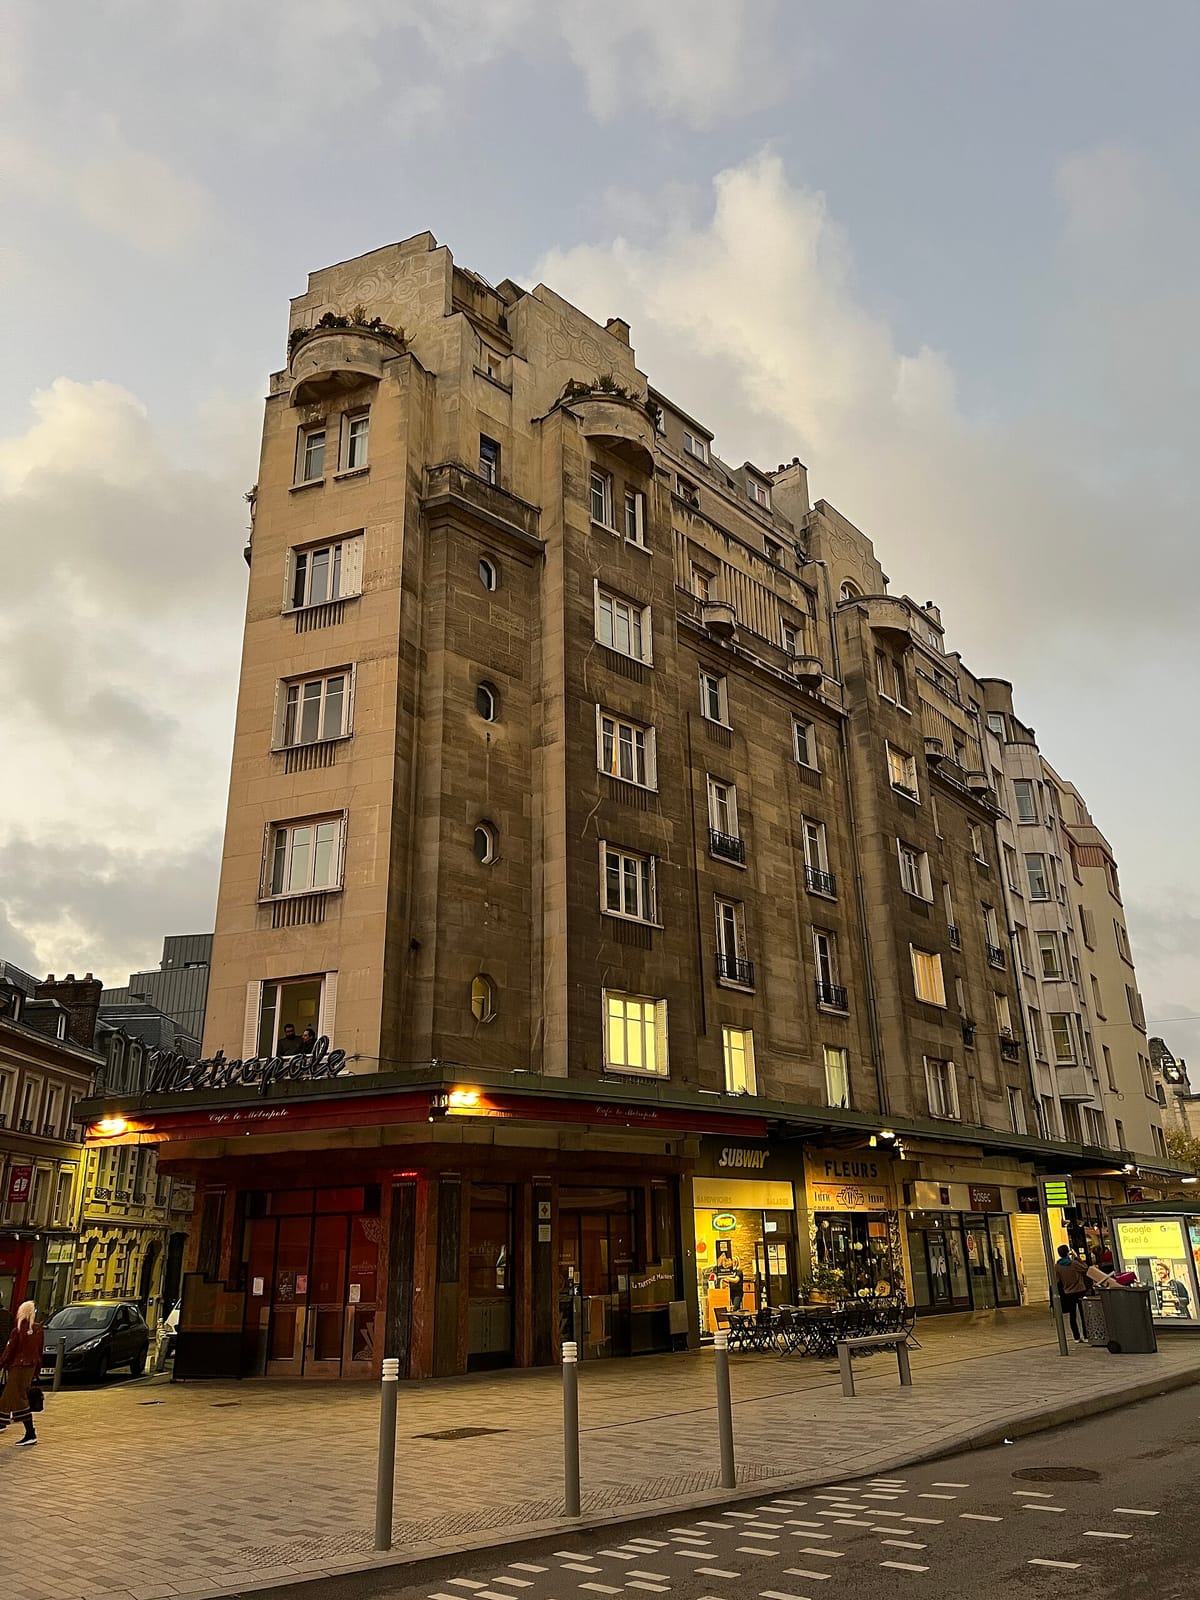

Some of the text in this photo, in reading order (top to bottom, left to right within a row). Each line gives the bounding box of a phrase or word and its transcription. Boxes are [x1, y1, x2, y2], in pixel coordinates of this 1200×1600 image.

[719, 1147, 770, 1169] SUBWAY
[824, 1160, 879, 1178] FLEURS
[1121, 1225, 1152, 1235] Google
[1123, 1235, 1142, 1244] Pixel
